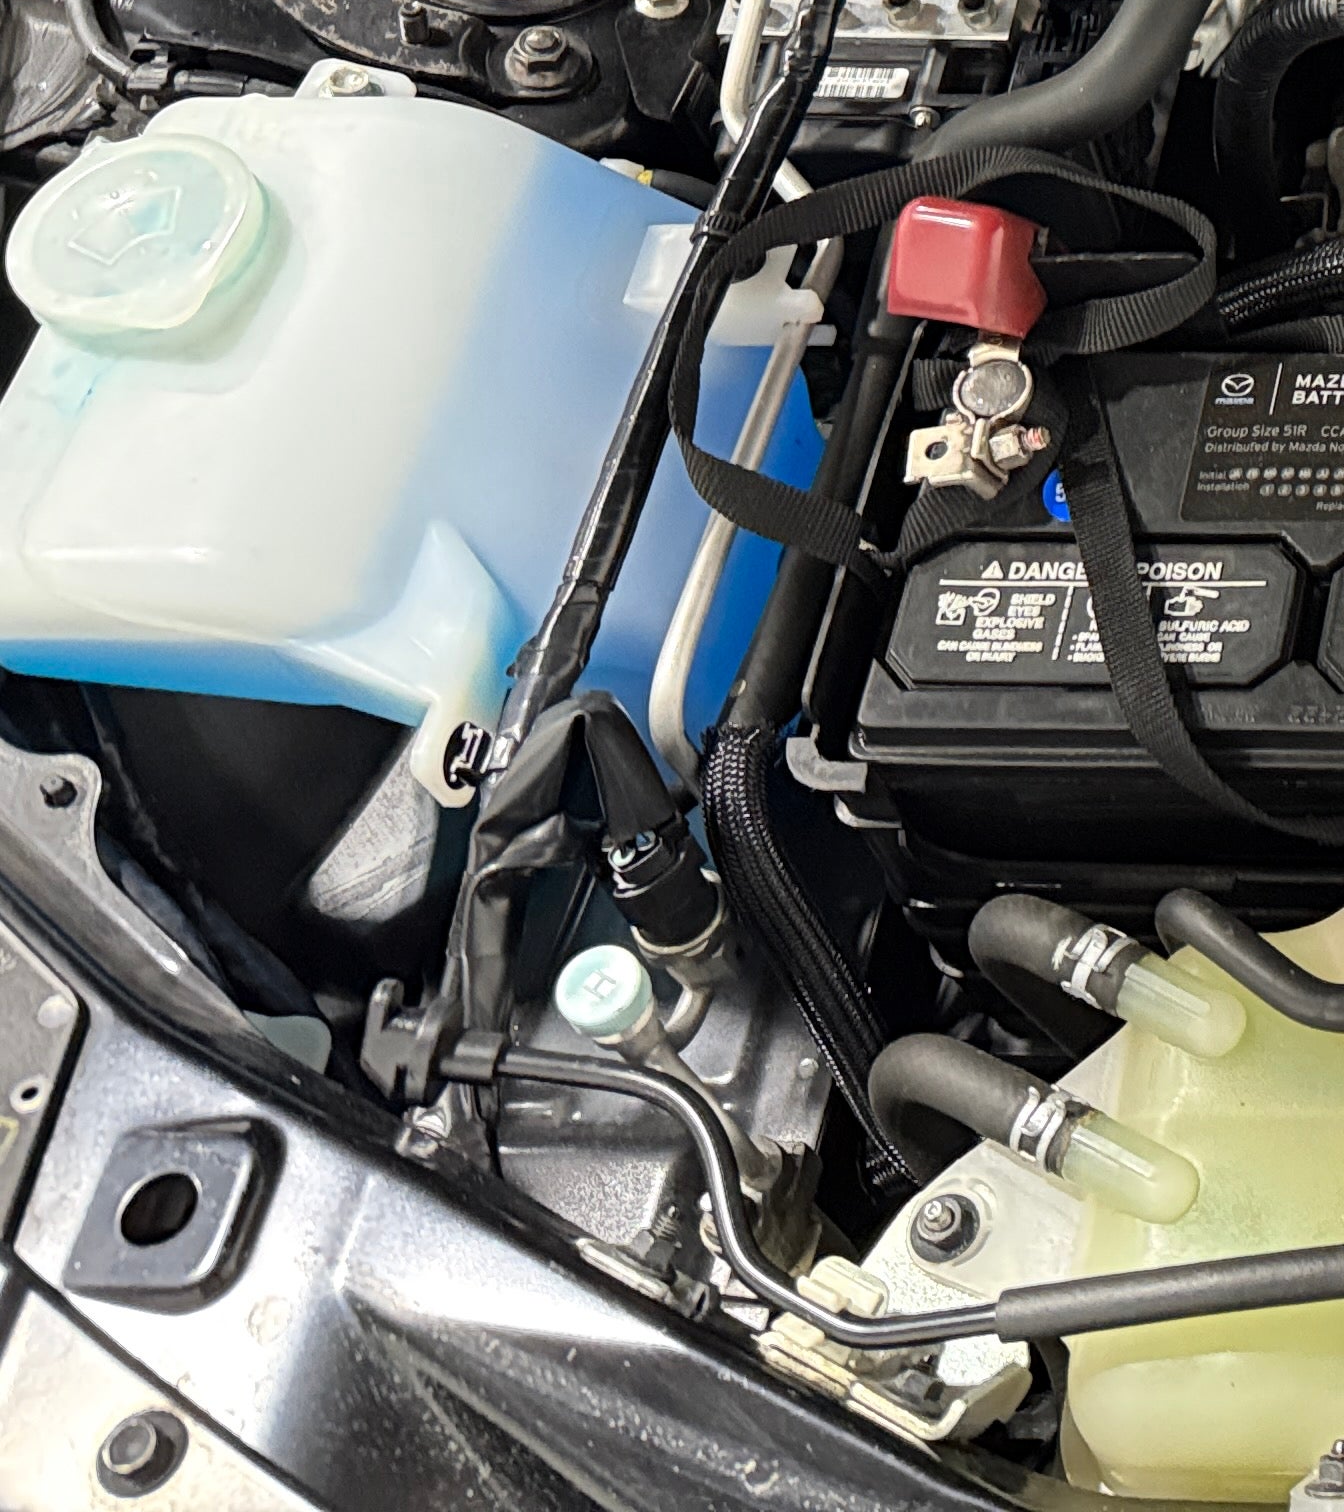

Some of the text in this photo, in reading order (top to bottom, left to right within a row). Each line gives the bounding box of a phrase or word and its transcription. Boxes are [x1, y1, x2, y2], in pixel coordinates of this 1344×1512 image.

[1207, 424, 1249, 439] Group
[1252, 424, 1280, 438] Size
[1283, 424, 1308, 438] 51R
[1205, 441, 1269, 453] Distributed
[1271, 441, 1286, 454] by
[1289, 441, 1326, 453] Mazda
[1007, 561, 1088, 581] DANGE
[1010, 593, 1057, 606] SHIELD
[1007, 605, 1041, 617] EYES
[975, 616, 1045, 629] EXPLOSIVE
[1219, 619, 1251, 632] ACID
[972, 628, 1016, 640] GASES
[583, 969, 617, 1000] H
